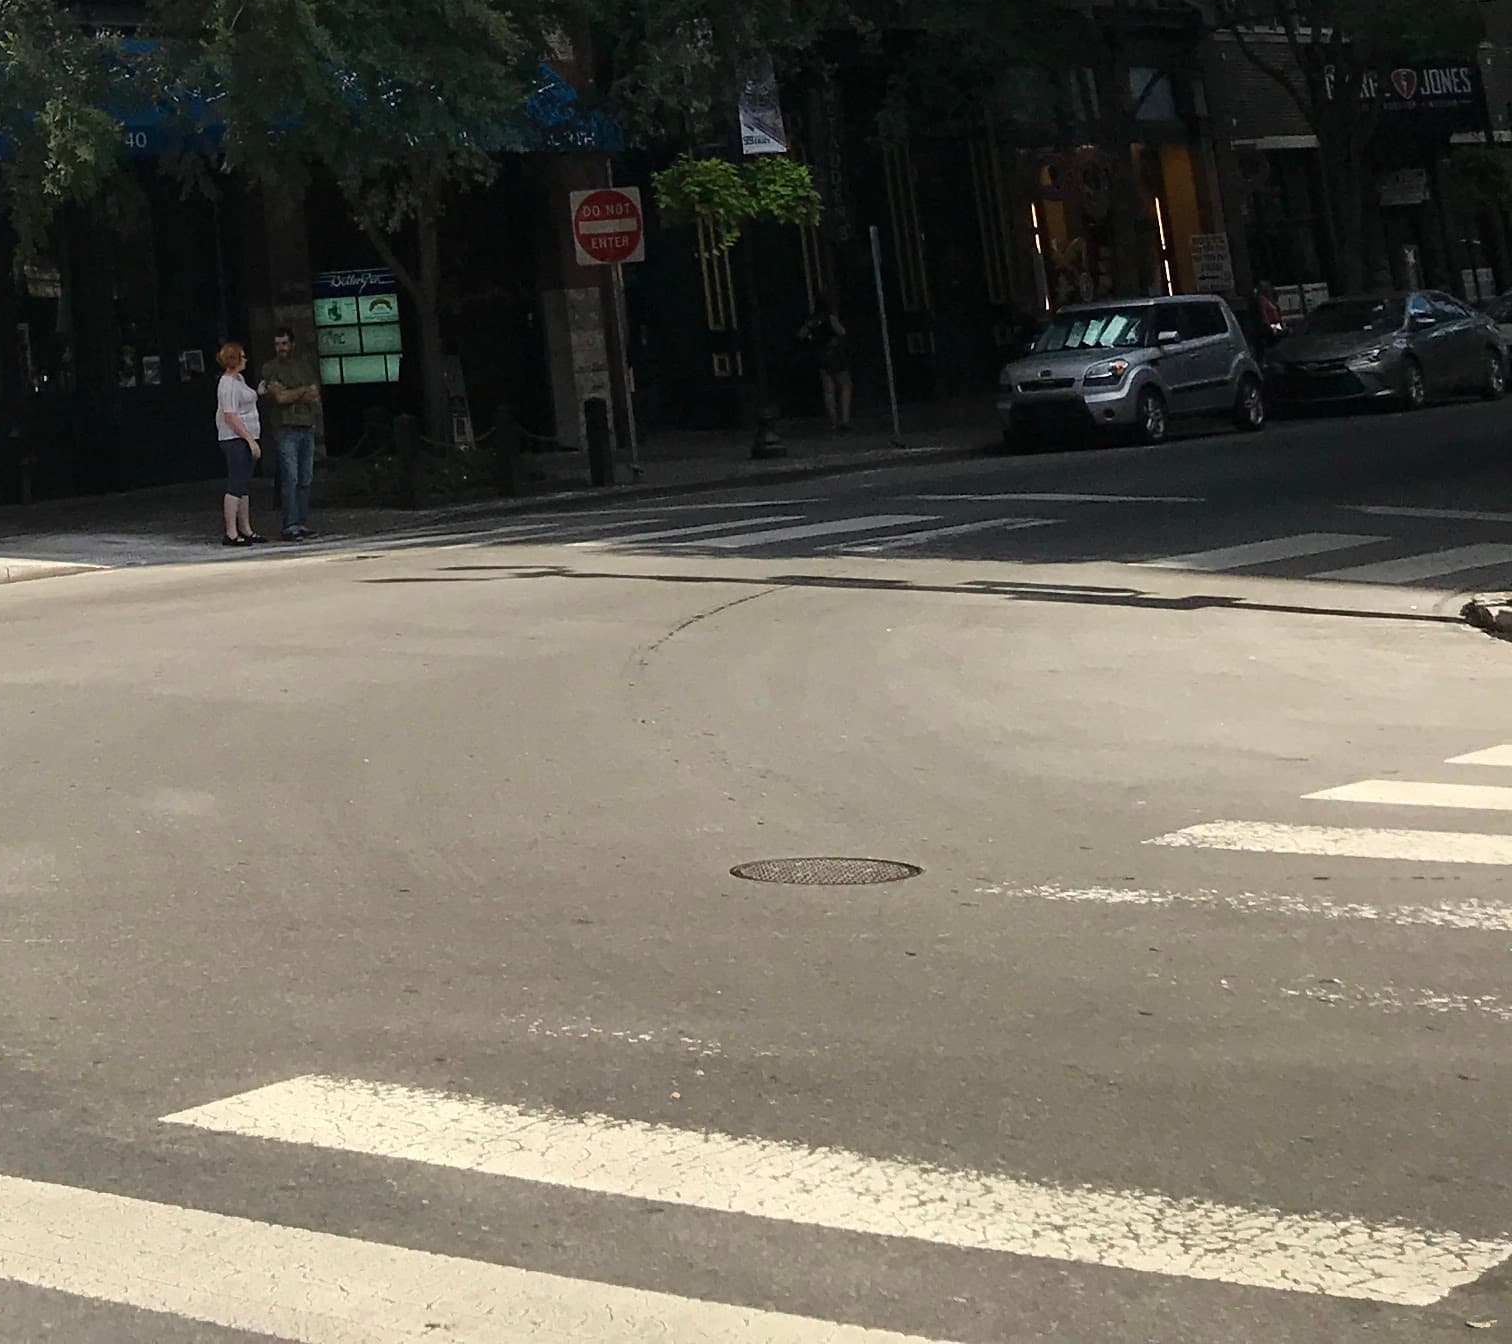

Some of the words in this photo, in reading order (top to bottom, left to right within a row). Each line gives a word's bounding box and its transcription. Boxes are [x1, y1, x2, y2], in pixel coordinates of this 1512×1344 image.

[1420, 67, 1472, 96] JONES
[582, 205, 600, 217] DO
[605, 202, 632, 216] NOT
[591, 235, 630, 250] ENTER
